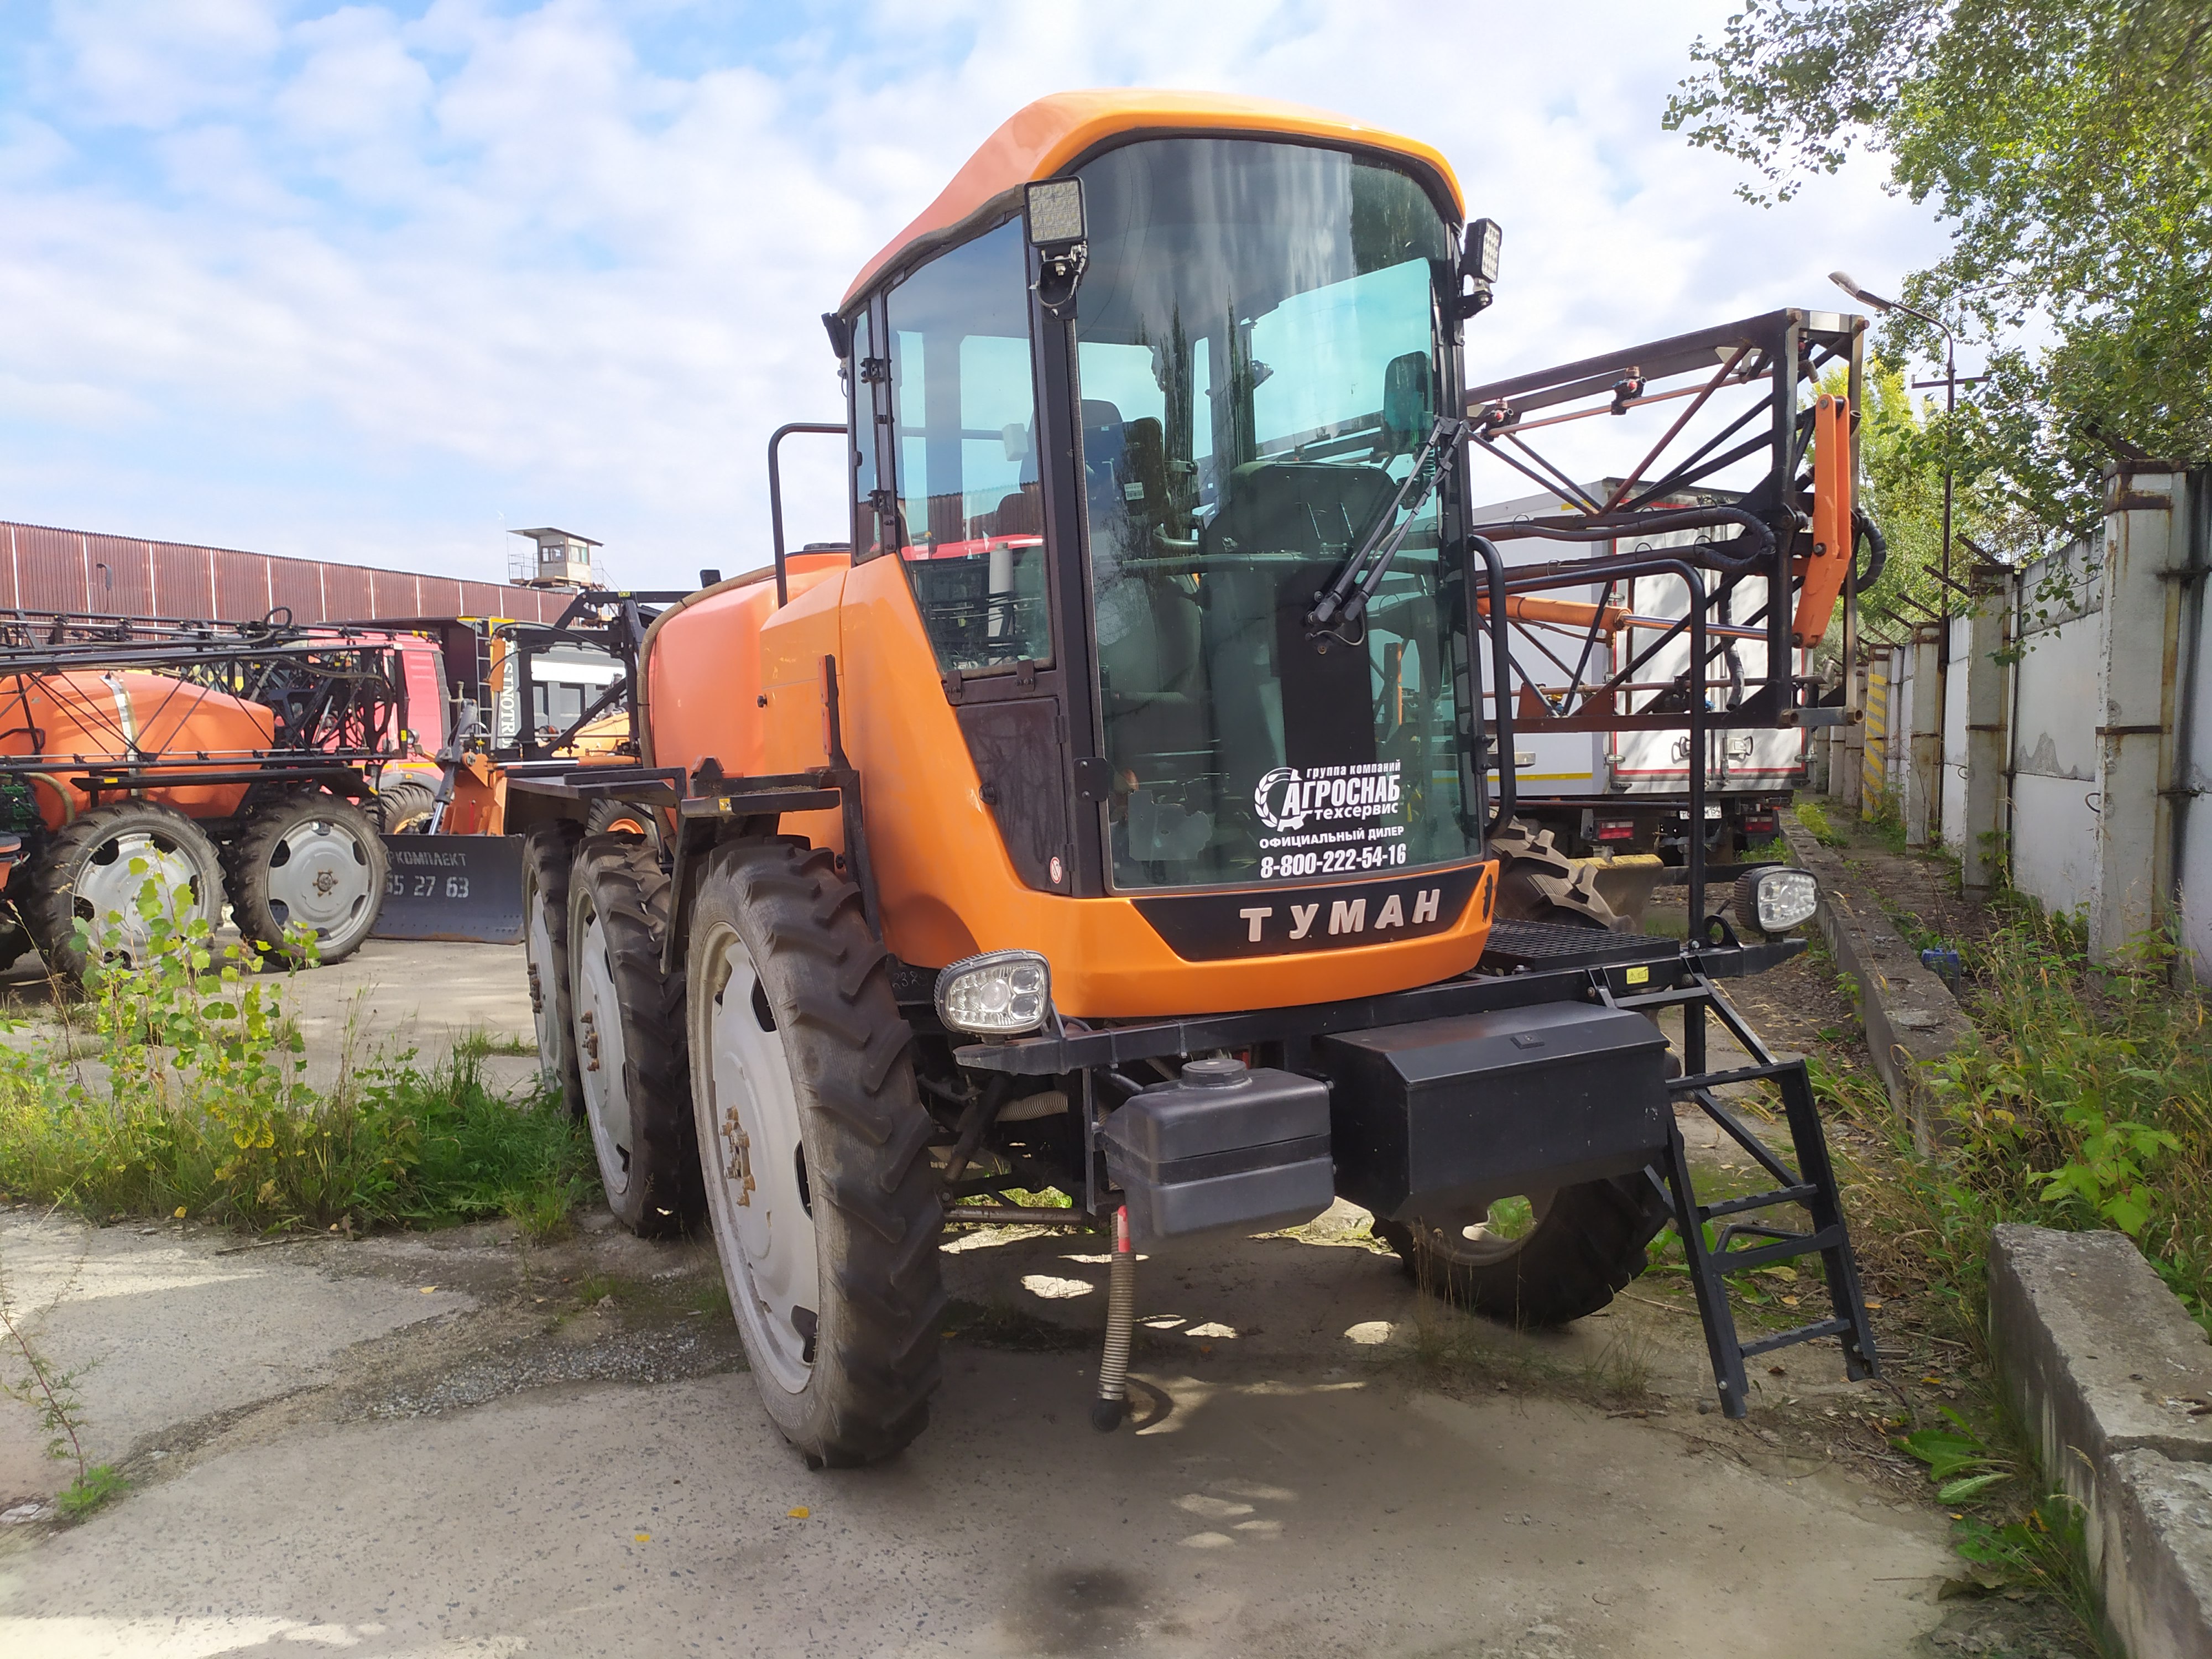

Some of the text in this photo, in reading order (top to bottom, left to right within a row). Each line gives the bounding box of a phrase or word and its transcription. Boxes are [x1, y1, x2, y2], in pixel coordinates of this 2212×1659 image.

[1306, 759, 1401, 780] группа компаний
[1281, 774, 1401, 817] АГРОСНАБ
[1314, 802, 1399, 820] техсервис
[1259, 826, 1405, 849] ОФИЦИАЛЬНЫЙ ДИЛЕР
[1260, 843, 1407, 879] 8-800-222-54-16
[414, 875, 436, 897] 27
[446, 876, 469, 898] 63
[1239, 888, 1441, 943] ТУМАН
